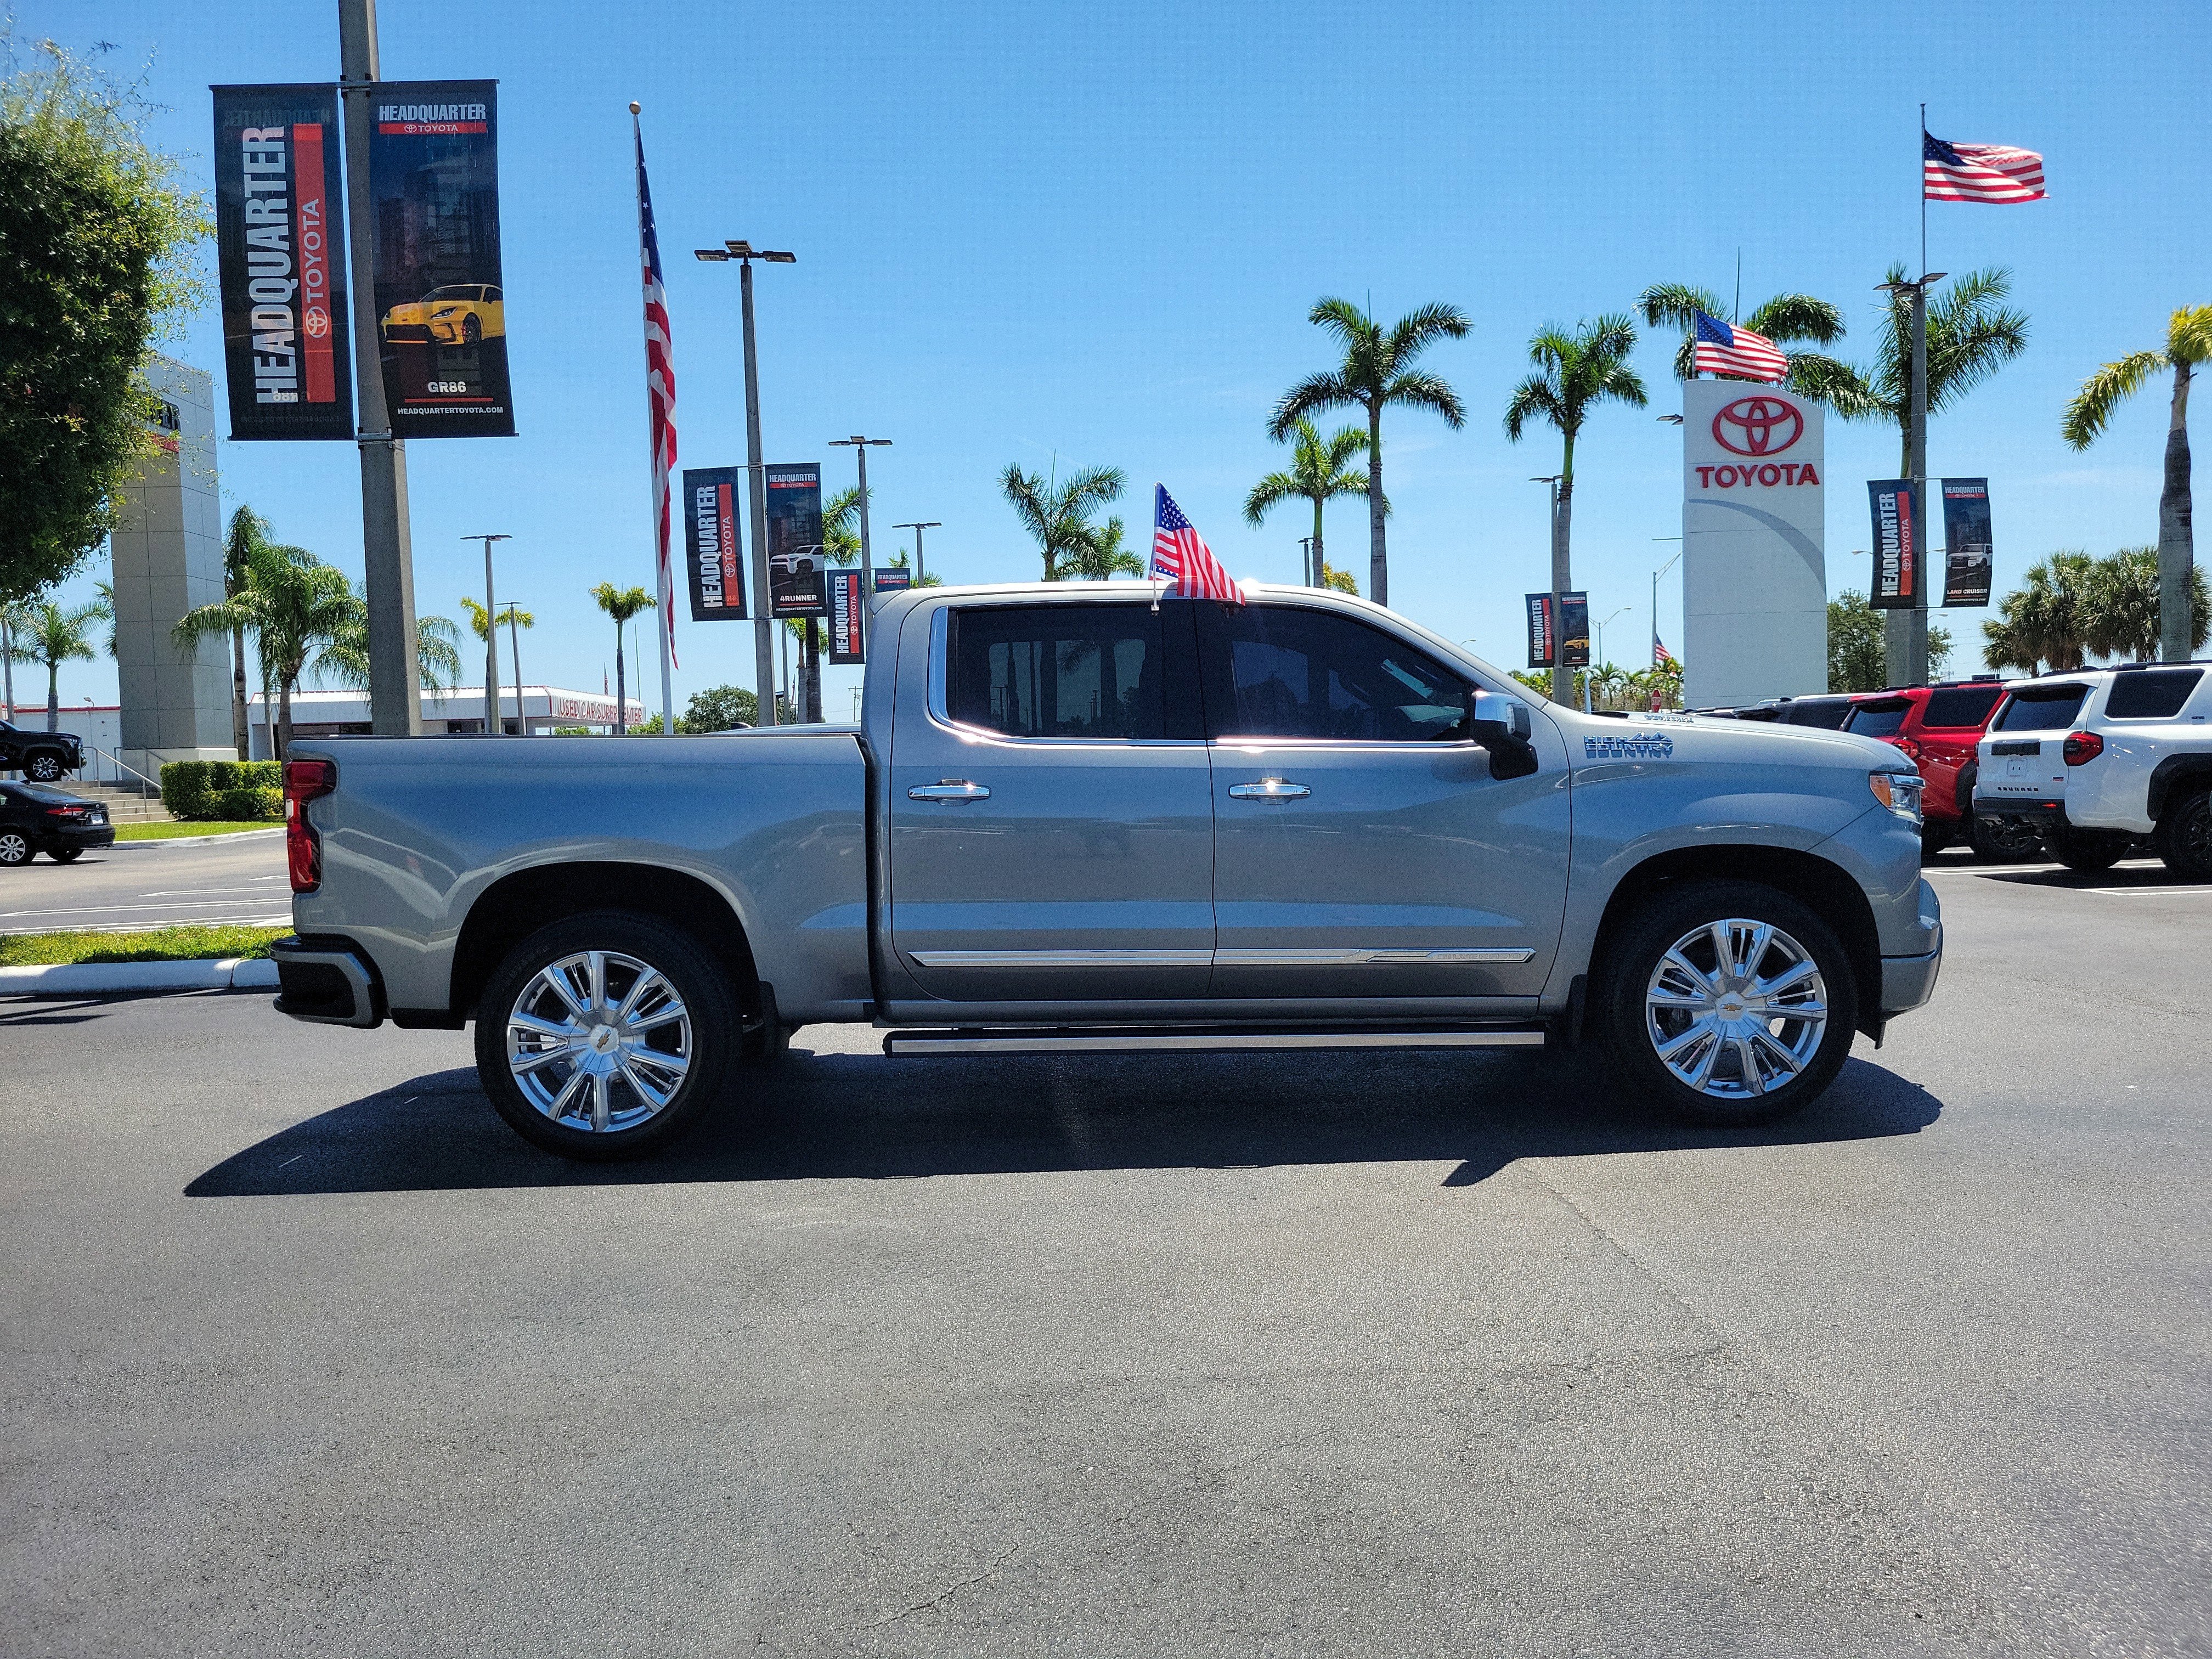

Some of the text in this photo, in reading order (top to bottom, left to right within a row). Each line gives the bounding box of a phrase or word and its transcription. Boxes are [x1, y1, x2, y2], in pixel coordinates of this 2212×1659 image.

[379, 104, 487, 123] HEADQUARTER
[418, 124, 459, 133] TOYOTA
[242, 126, 298, 404] HEADQUARTER
[298, 199, 325, 300] TOYOTA
[428, 381, 466, 393] GR86
[398, 406, 504, 415] HEADQUARTERTOYOTA.COM
[769, 473, 816, 483] HEADQUARTER
[1695, 462, 1820, 489] TOYOTA
[697, 486, 723, 608] HEADQUARTER
[723, 516, 733, 562] TOYOTA
[1878, 493, 1901, 597] HEADQUARTER
[1902, 518, 1910, 558] TOYOTA
[834, 575, 850, 654] HEADQUARTER
[1532, 599, 1545, 661] HEADQUARTER
[560, 698, 579, 717] USED
[581, 701, 596, 719] CAR
[624, 707, 642, 722] ENTER
[1585, 743, 1673, 752] COUNTRY
